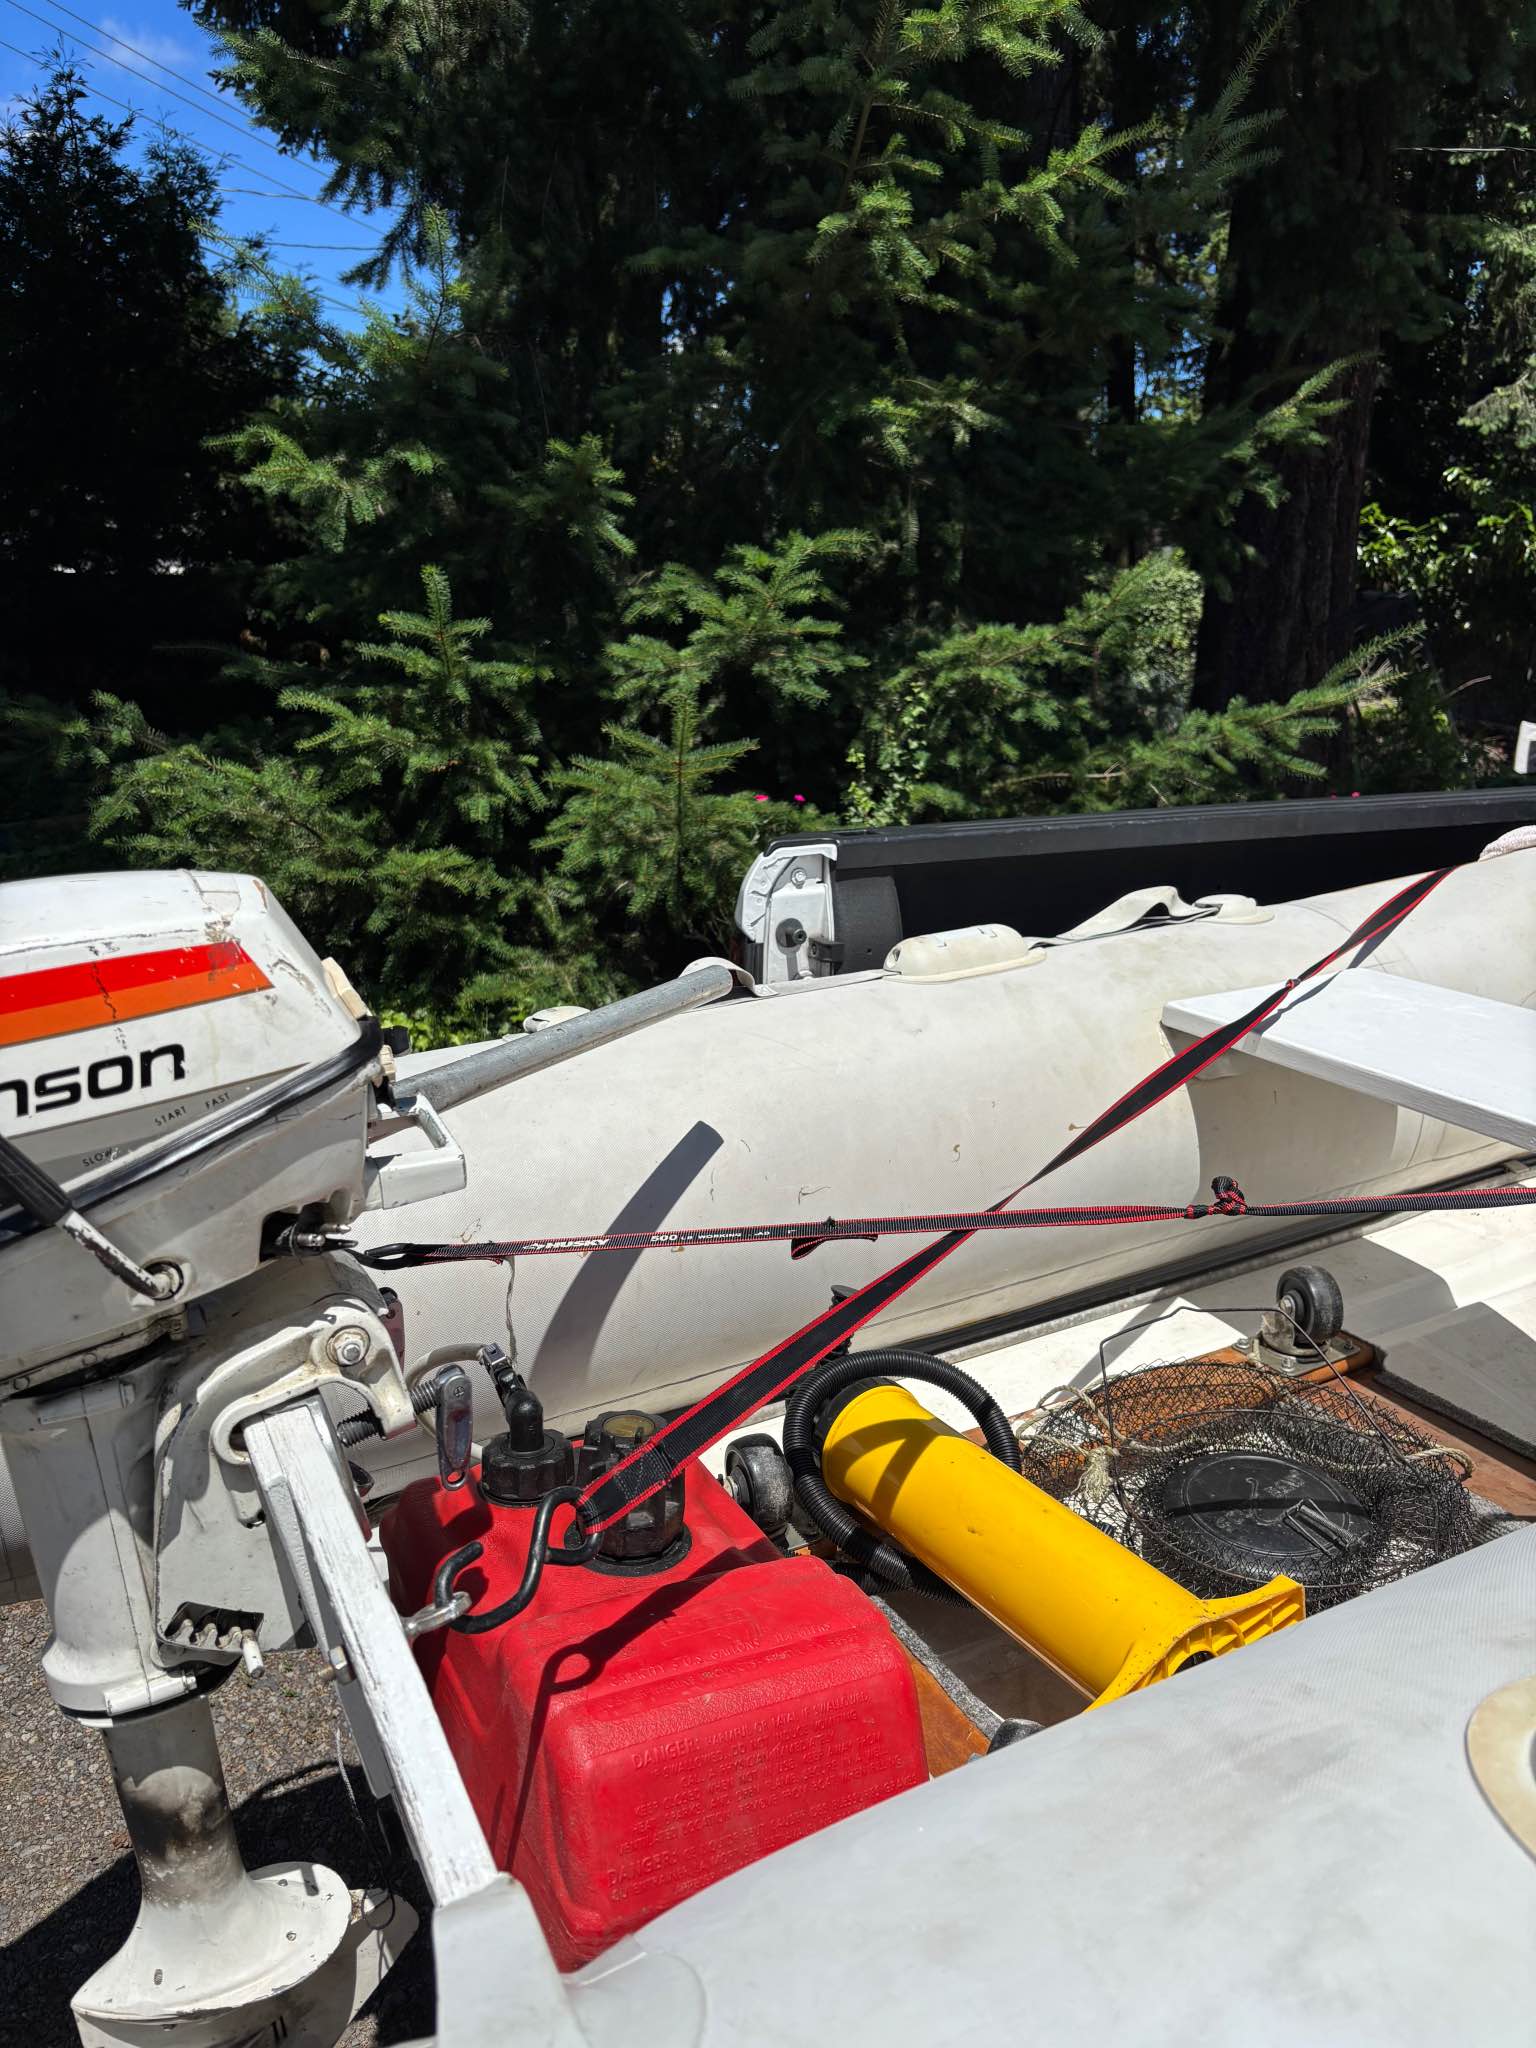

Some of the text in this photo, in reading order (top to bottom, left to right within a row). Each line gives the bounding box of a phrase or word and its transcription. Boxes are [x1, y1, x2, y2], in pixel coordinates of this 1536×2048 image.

[153, 1092, 232, 1127] START FAST
[82, 1146, 114, 1168] SLOW
[547, 1238, 611, 1250] HUSKY
[651, 1234, 678, 1243] 500
[698, 1232, 744, 1241] WORKING
[631, 1737, 700, 1769] DANGER:
